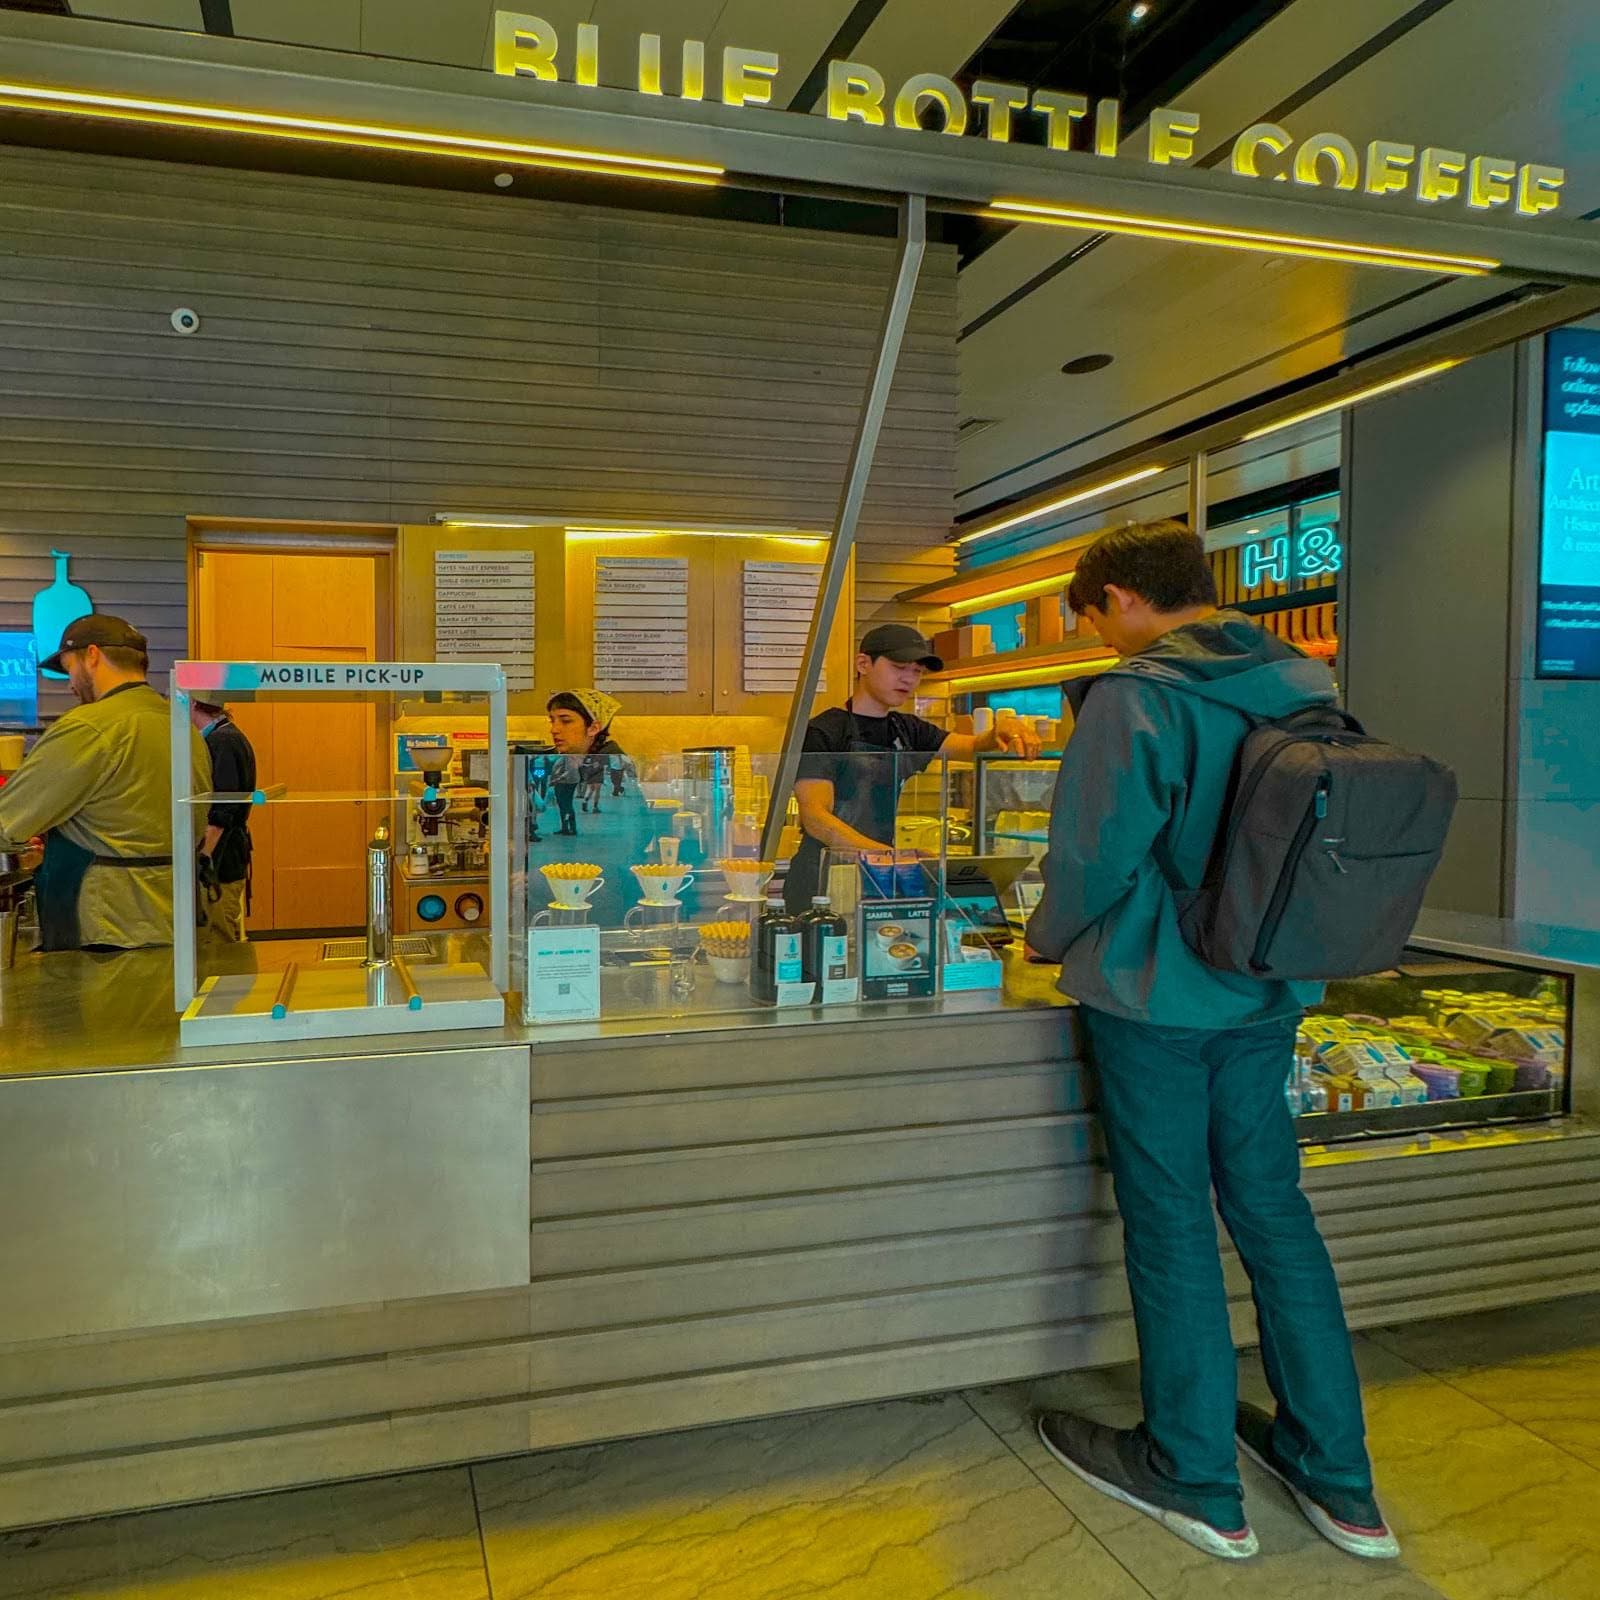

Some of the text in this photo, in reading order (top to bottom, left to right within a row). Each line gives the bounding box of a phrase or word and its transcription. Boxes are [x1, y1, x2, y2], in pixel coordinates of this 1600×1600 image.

[260, 667, 425, 684] MOBILE PICK-UP
[865, 910, 931, 920] SAMBA LATTE
